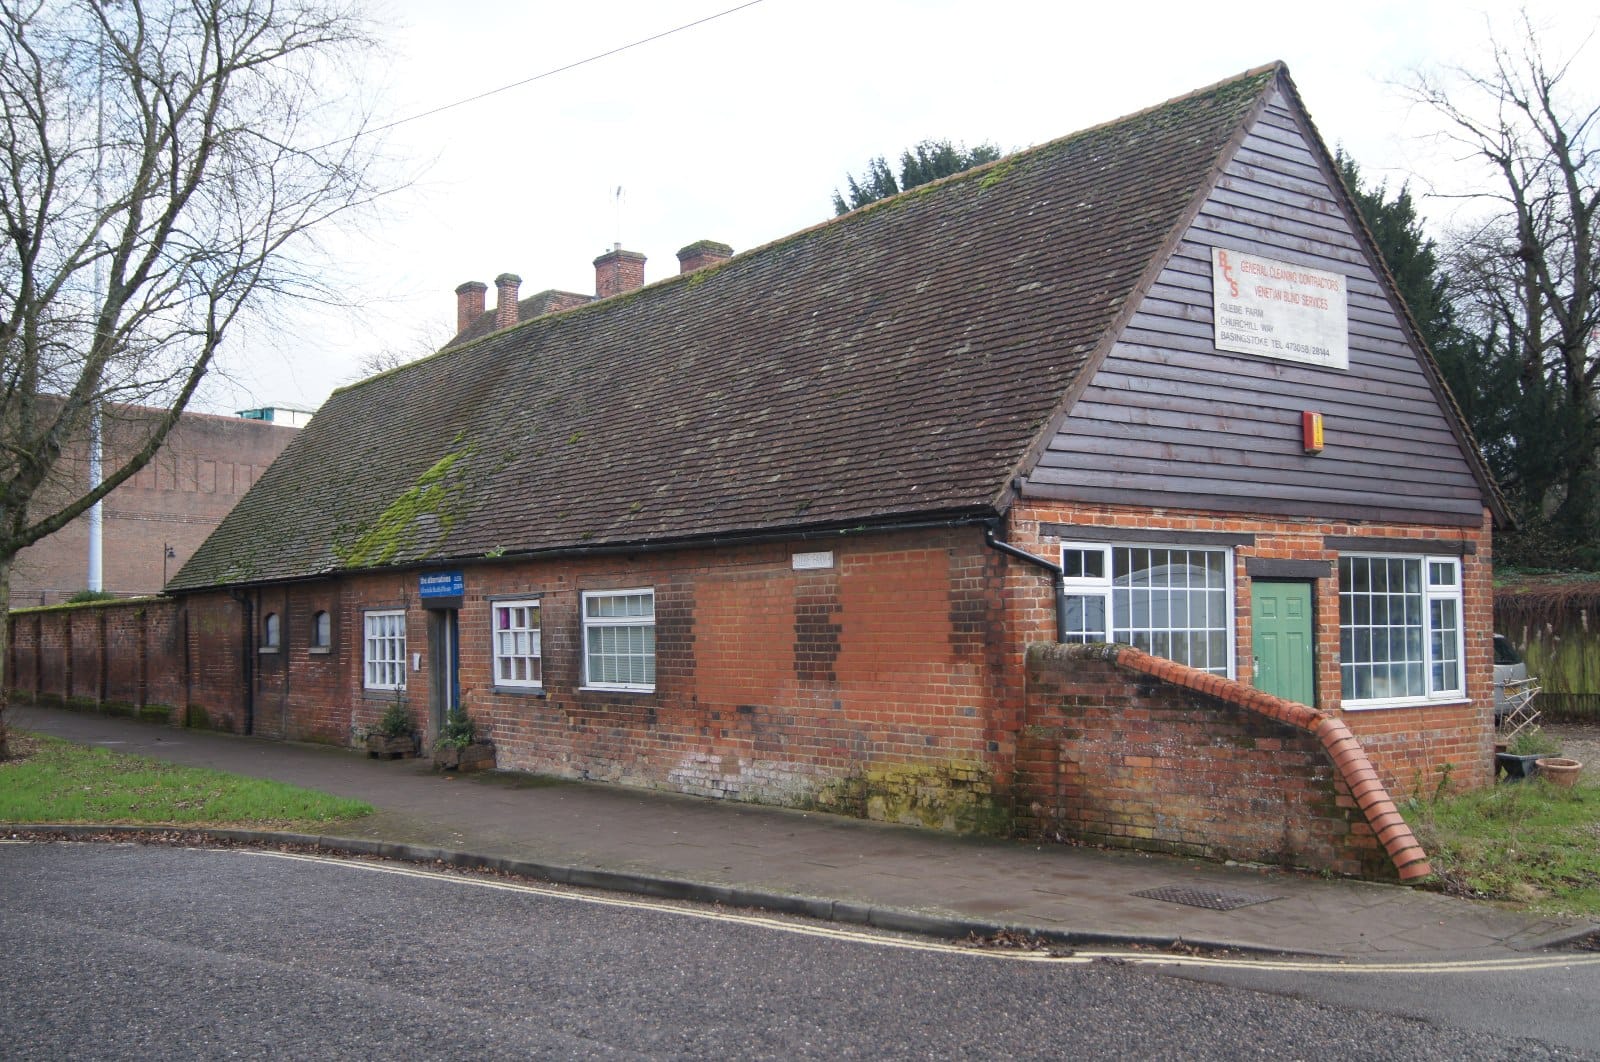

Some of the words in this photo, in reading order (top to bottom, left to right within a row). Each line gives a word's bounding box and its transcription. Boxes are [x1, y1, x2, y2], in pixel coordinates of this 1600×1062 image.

[1241, 260, 1268, 277] GENERAL
[1270, 266, 1297, 284] CLEANING
[1299, 273, 1339, 291] CONTRACTORS
[1255, 286, 1282, 300] VENETIAN
[1283, 291, 1300, 304] BLIND
[1302, 294, 1328, 310] SERVICES
[1245, 307, 1264, 318] FARM
[1220, 316, 1258, 331] CHURCHILL
[1220, 331, 1269, 347] BASINGSTOKE
